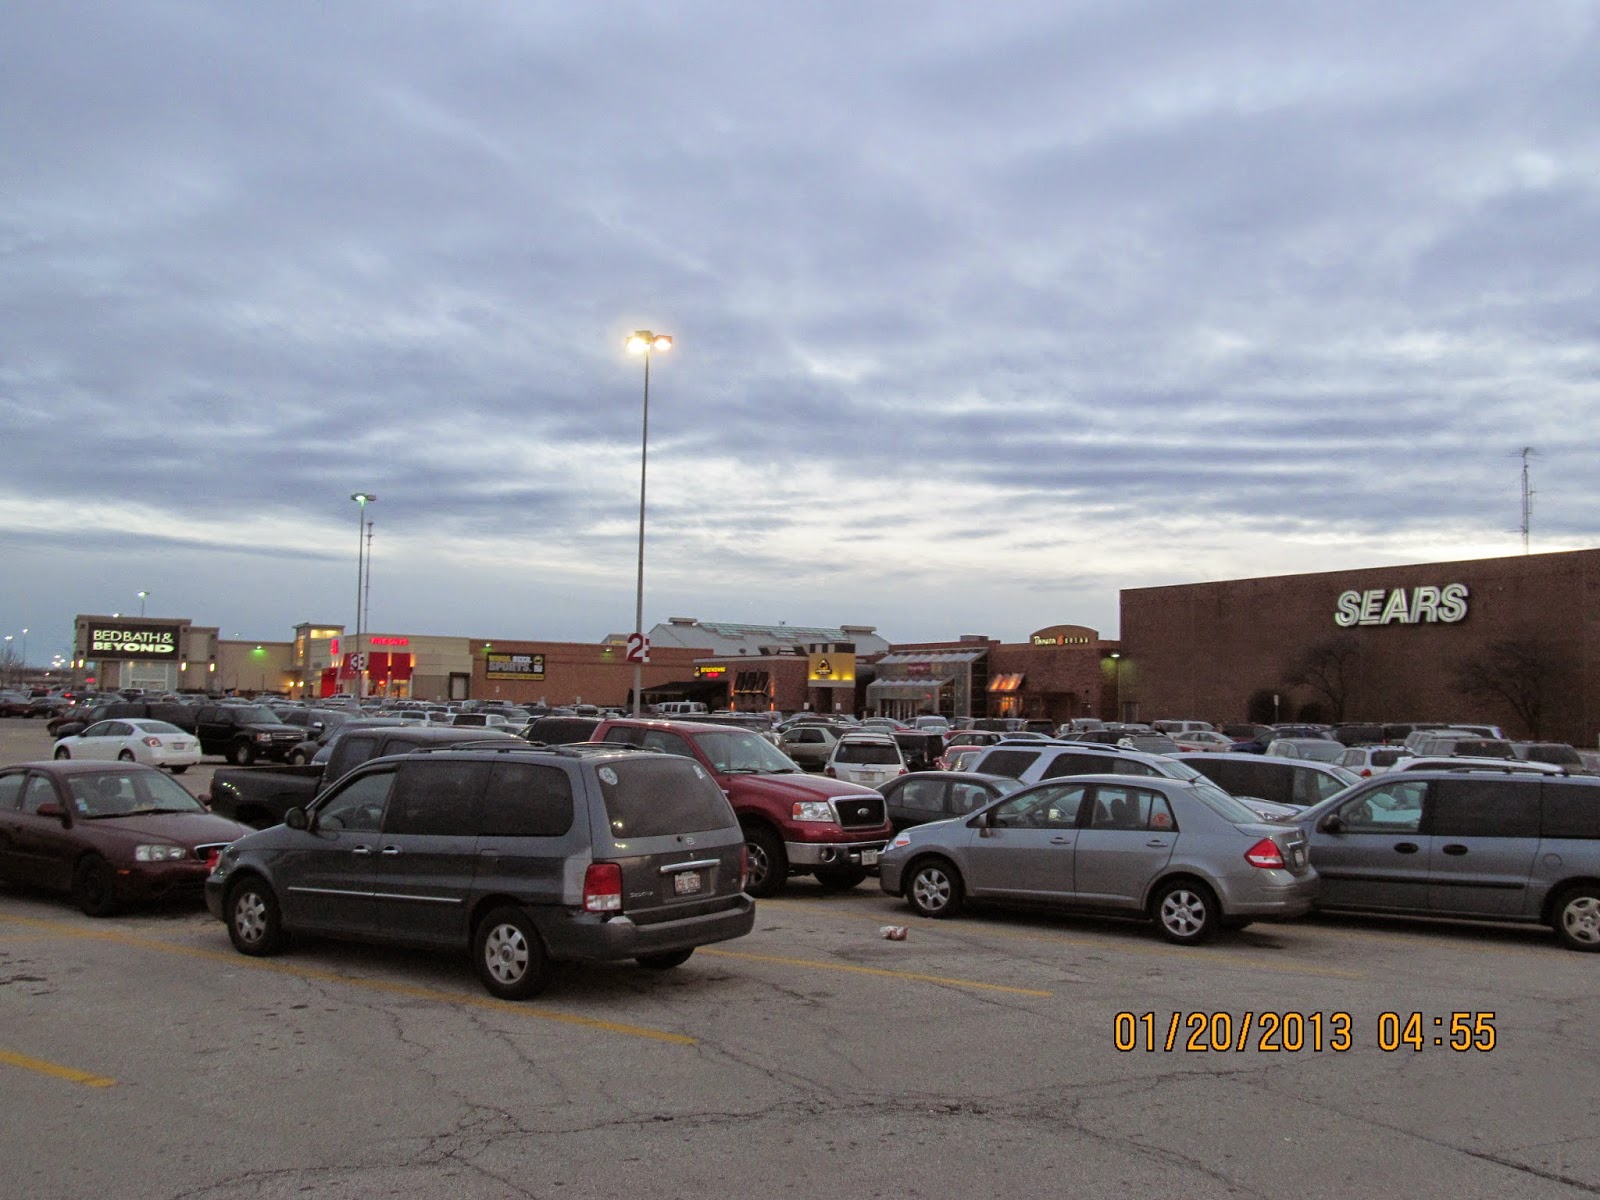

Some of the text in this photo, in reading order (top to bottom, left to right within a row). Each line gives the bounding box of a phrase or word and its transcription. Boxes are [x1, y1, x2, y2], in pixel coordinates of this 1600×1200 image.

[1335, 583, 1468, 627] SEARS
[93, 630, 174, 644] BED BATH &
[92, 642, 175, 653] BEYOND
